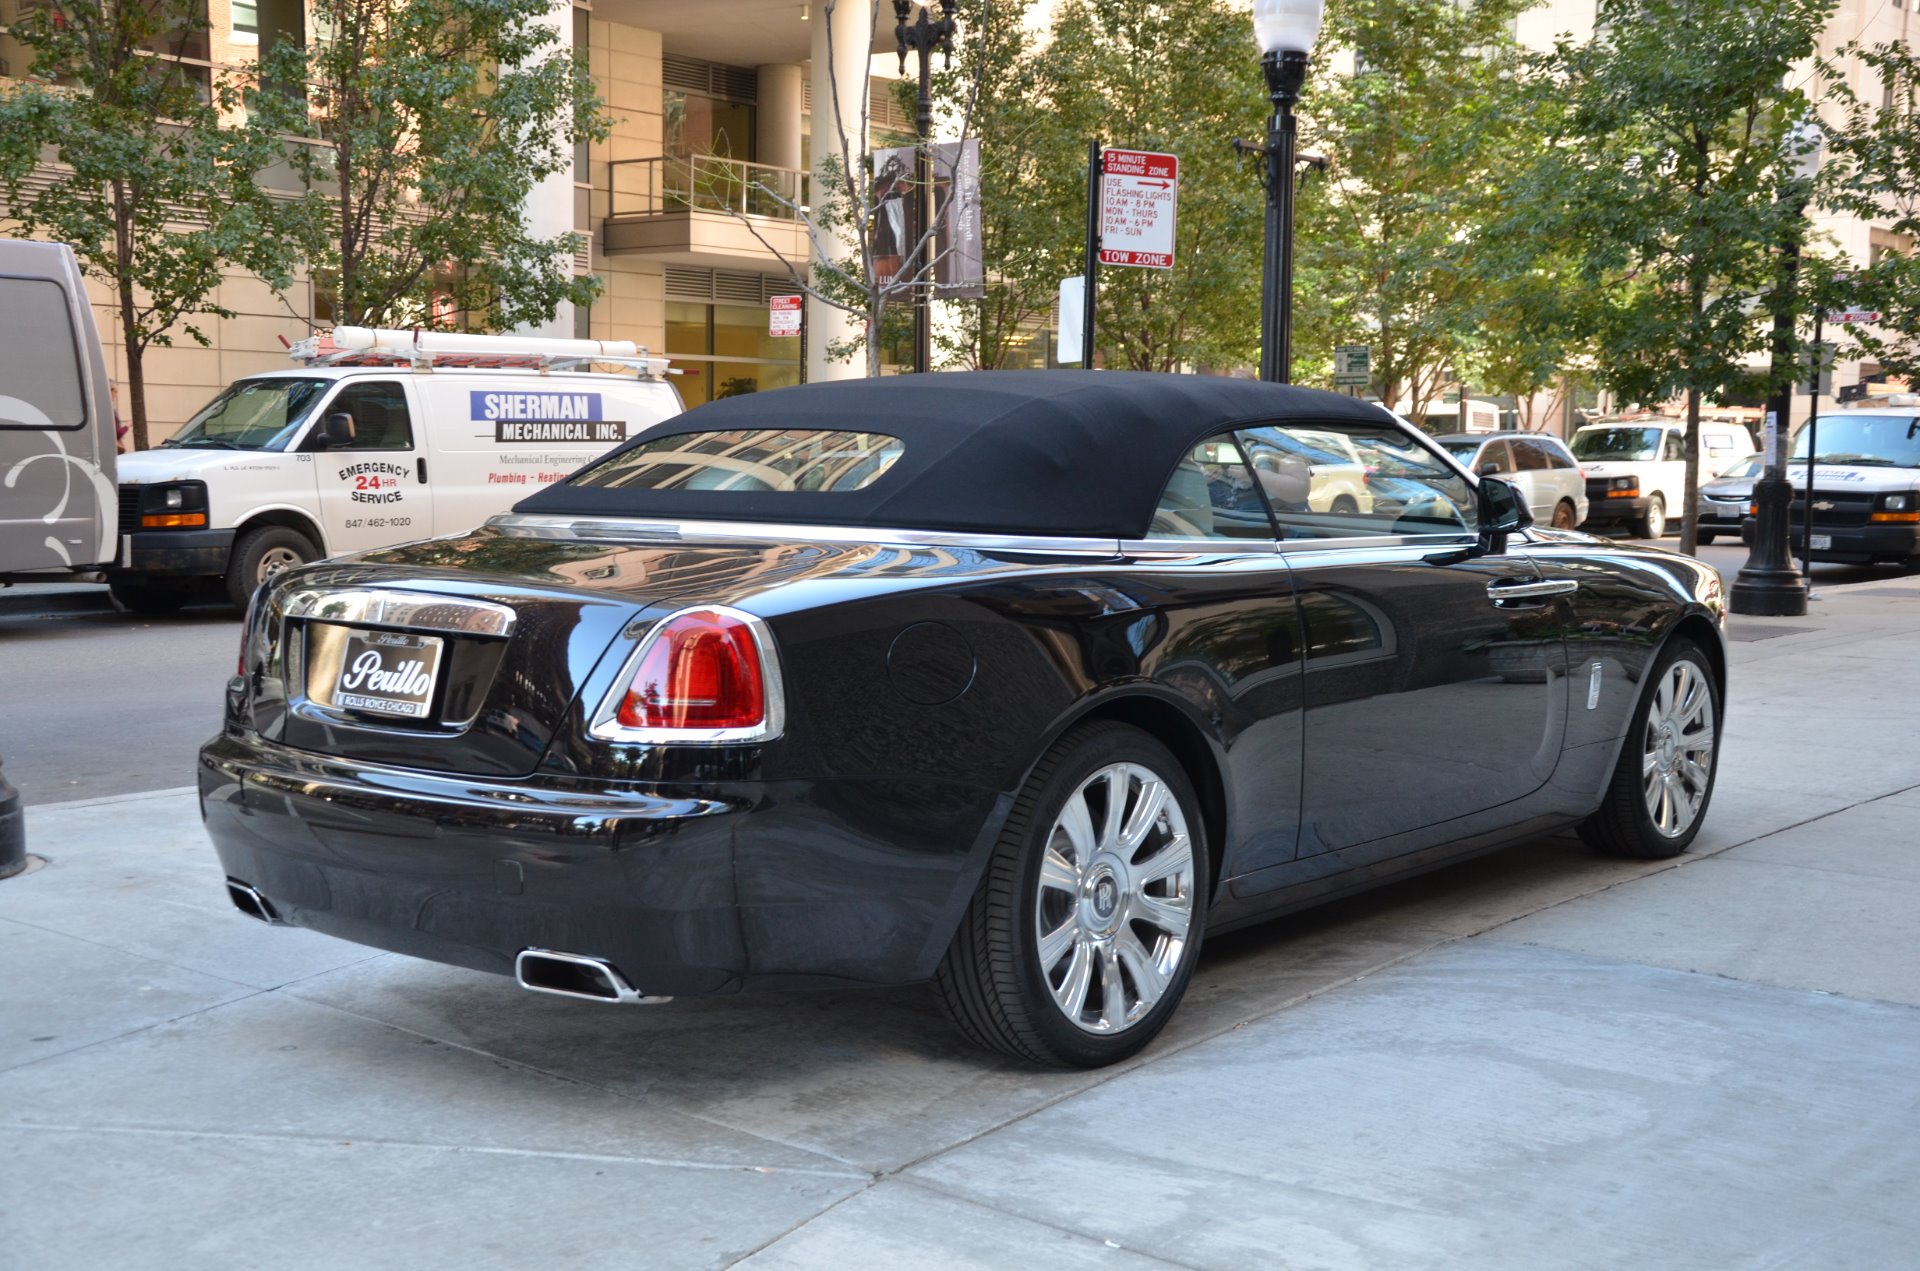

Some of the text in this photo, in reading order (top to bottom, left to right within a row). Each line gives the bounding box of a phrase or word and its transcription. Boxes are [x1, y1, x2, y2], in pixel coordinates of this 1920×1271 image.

[1107, 153, 1147, 164] 15 MINUTE
[1107, 163, 1169, 176] STANDING ZONE
[1106, 178, 1122, 187] USE
[1106, 187, 1172, 201] FLASHING LIGHTS
[1106, 197, 1114, 205] 10
[1136, 199, 1141, 207] 8
[1105, 207, 1123, 215] MON
[1132, 209, 1158, 218] THURS
[1105, 216, 1114, 224] 10
[1115, 217, 1127, 225] AM
[1135, 218, 1140, 226] 6
[1141, 219, 1153, 228] PM
[1105, 226, 1118, 234] FRI
[1125, 228, 1142, 236] SUN
[1104, 251, 1167, 265] TOW ZONE
[484, 393, 589, 420] SHERMAN
[502, 423, 622, 440] MECHANICAL INC.
[499, 454, 542, 464] Mechanical
[544, 455, 587, 467] Engineering
[338, 462, 410, 480] EMERGENCY
[355, 475, 397, 490] 24 HR
[488, 472, 527, 484] Plumbing
[538, 472, 569, 483] Heatin
[351, 491, 403, 504] SERVICE
[345, 517, 411, 529] 847/462-1020
[343, 650, 430, 696] Perillo
[345, 696, 414, 713] ROLLS ROYCE CHICAGO
